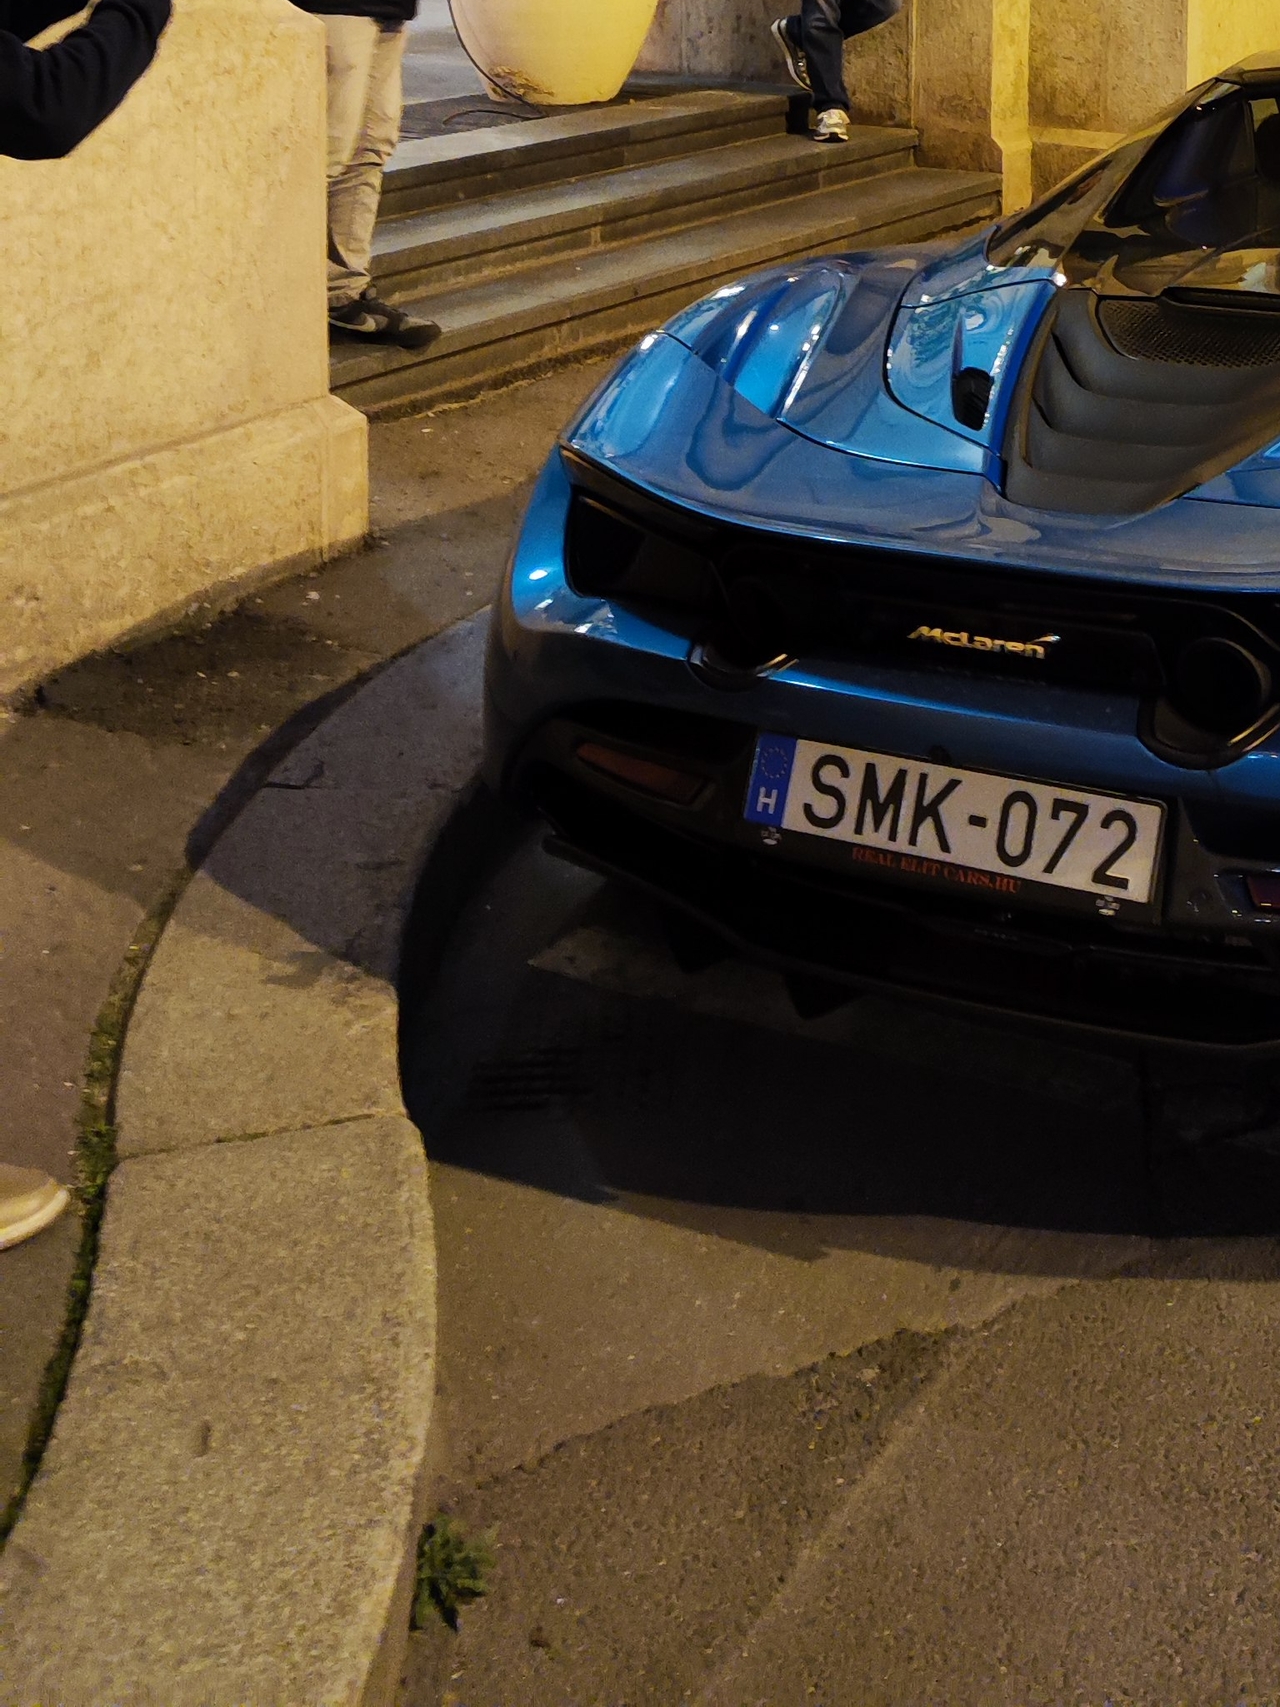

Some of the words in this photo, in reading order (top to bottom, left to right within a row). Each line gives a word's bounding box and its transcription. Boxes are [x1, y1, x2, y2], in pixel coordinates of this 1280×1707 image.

[906, 625, 1047, 660] McLaren
[755, 786, 778, 815] H
[802, 754, 1138, 891] SMK-072
[852, 846, 896, 868] REAL
[901, 856, 941, 877] ELIT
